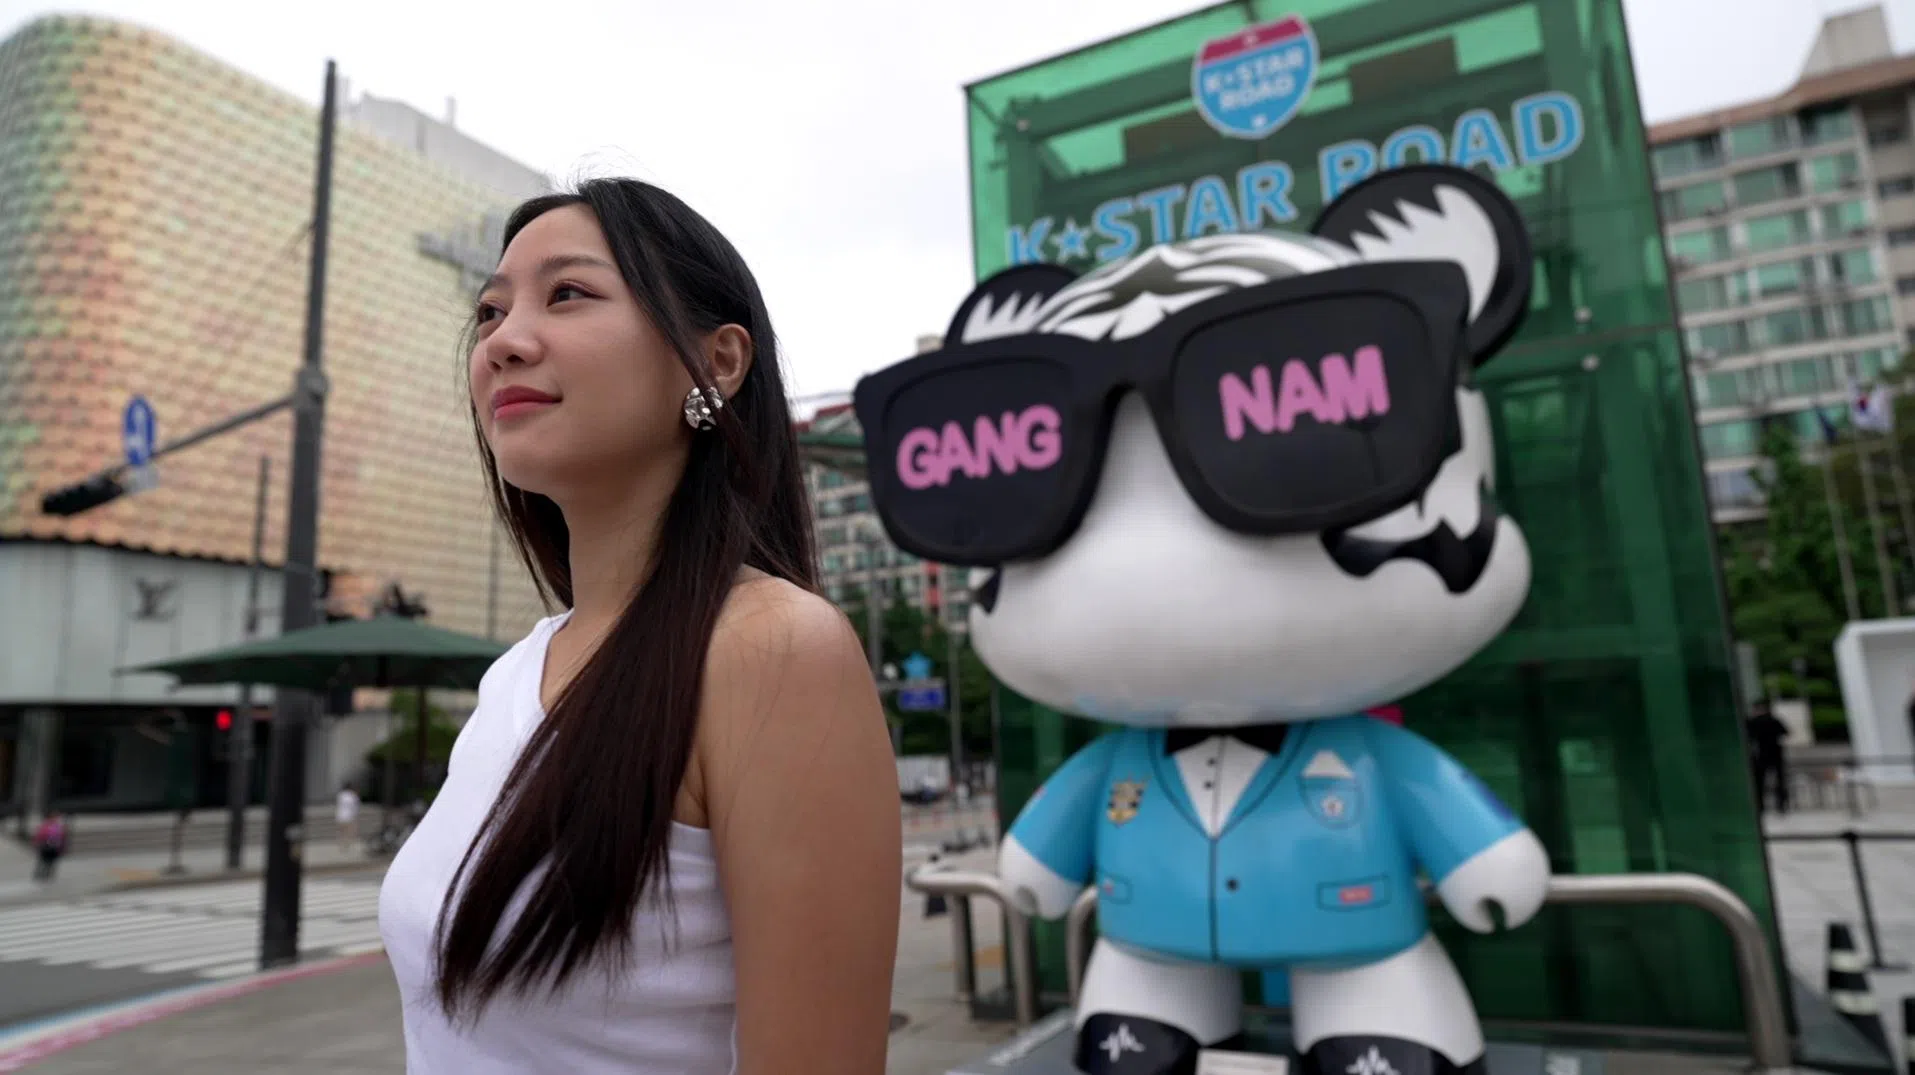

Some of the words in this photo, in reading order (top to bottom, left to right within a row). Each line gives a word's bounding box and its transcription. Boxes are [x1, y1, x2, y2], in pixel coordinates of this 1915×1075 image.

[1219, 74, 1295, 111] ROAD
[896, 403, 1062, 490] GANG
[1218, 344, 1390, 442] NAM
